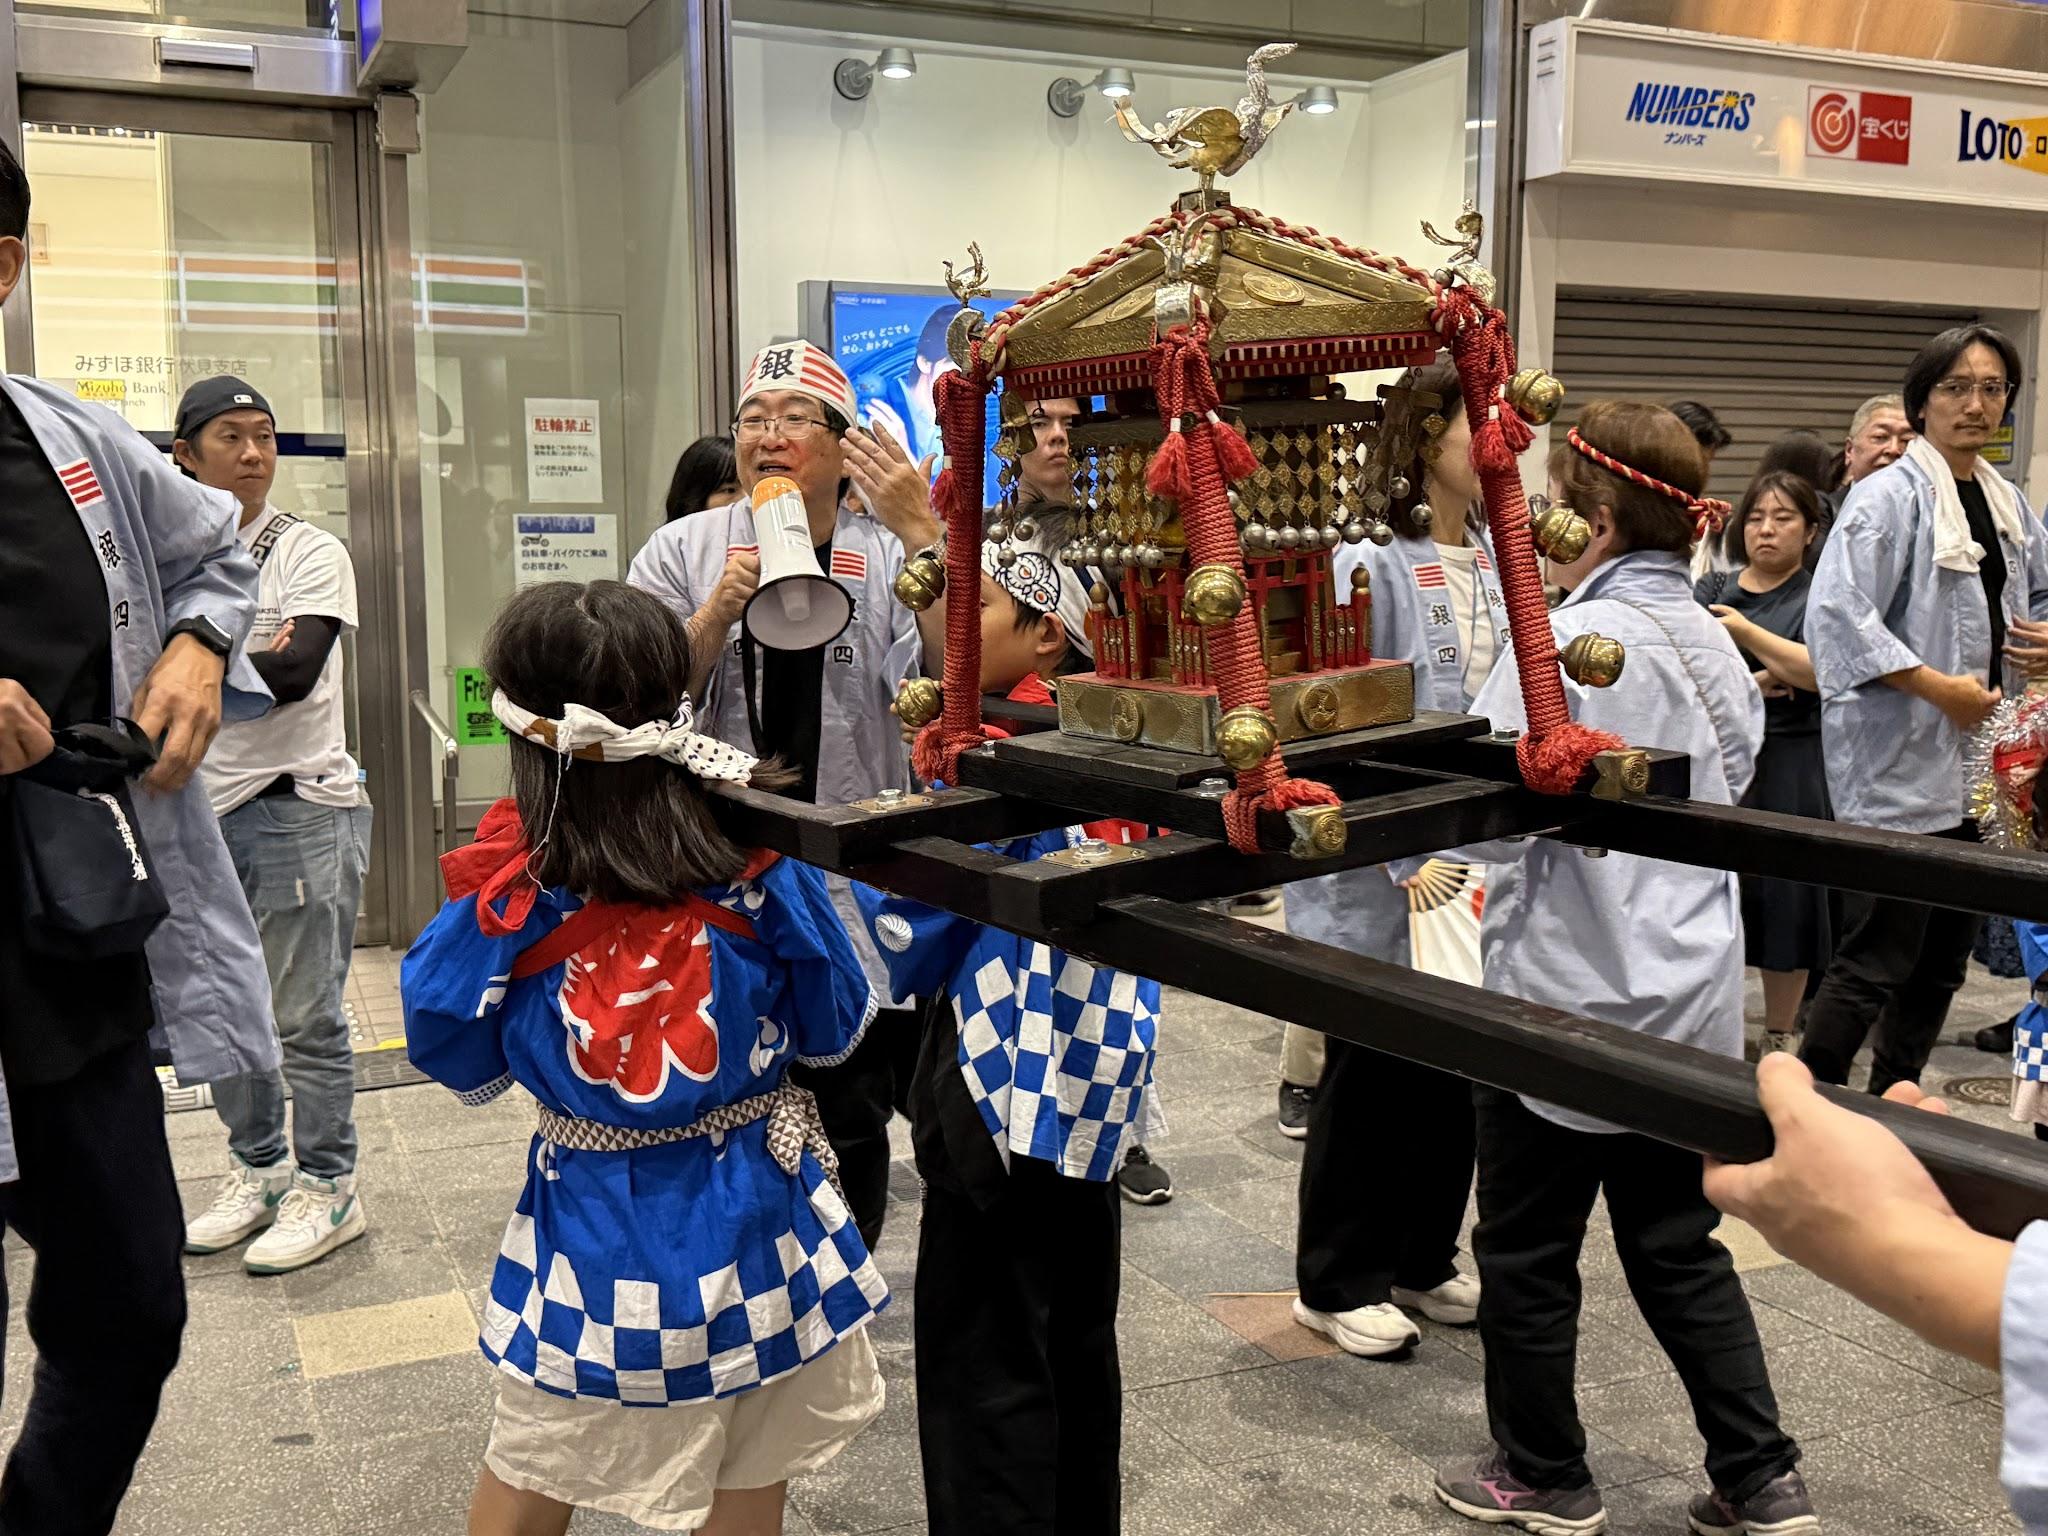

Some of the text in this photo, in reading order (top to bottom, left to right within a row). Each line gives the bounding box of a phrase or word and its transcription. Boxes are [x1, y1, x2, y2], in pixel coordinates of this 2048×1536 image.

[1626, 82, 1756, 131] NUMBERS
[1664, 131, 1707, 146] ナンバーズ
[1861, 116, 1909, 141] 宝くじ
[1958, 109, 2022, 161] LOTO
[843, 323, 911, 343] いつでも どこでも
[75, 355, 175, 375] みずほ銀行
[758, 348, 795, 380] 銀
[76, 381, 127, 394] Mizuho
[133, 382, 170, 396] Bank,
[534, 418, 592, 433] 駐輪禁止
[522, 562, 568, 570] のお客さまへ
